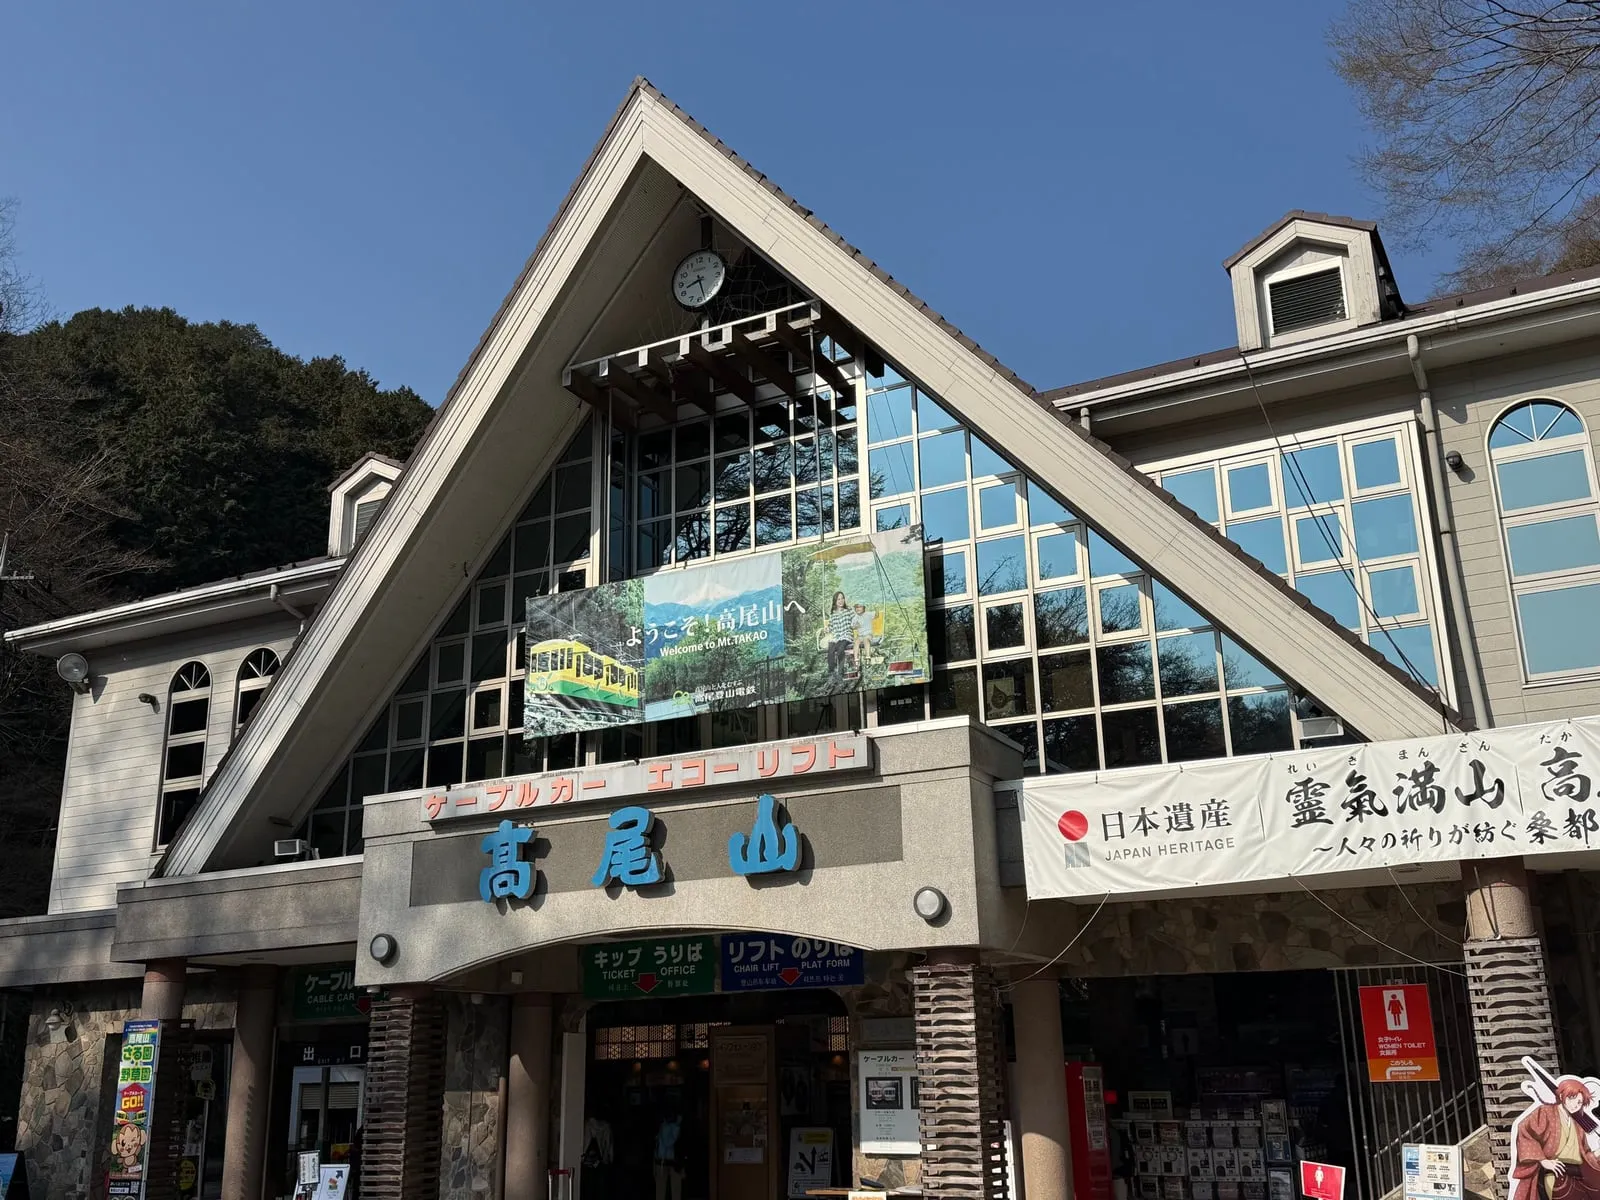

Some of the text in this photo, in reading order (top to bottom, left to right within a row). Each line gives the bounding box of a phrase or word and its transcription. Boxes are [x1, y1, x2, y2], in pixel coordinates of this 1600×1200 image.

[696, 256, 703, 264] 12
[660, 630, 768, 657] Welcome to Mt.TAKAO
[1540, 731, 1573, 745] たか
[425, 740, 856, 818] ケーブルカー エコーリフト
[1539, 746, 1600, 802] 高
[1101, 798, 1233, 842] 日本遺産
[1105, 837, 1236, 861] JAPAN HERITAGE
[594, 943, 703, 968] キップ うりば
[729, 940, 784, 963] リフト
[602, 965, 696, 980] TICKET OFFICE
[734, 963, 779, 974] CHAIR LIFT
[801, 959, 850, 970] PLAT FORM
[305, 971, 354, 993] ケーブル
[307, 993, 355, 1004] CABLE CAR
[122, 1095, 144, 1109] GO!!
